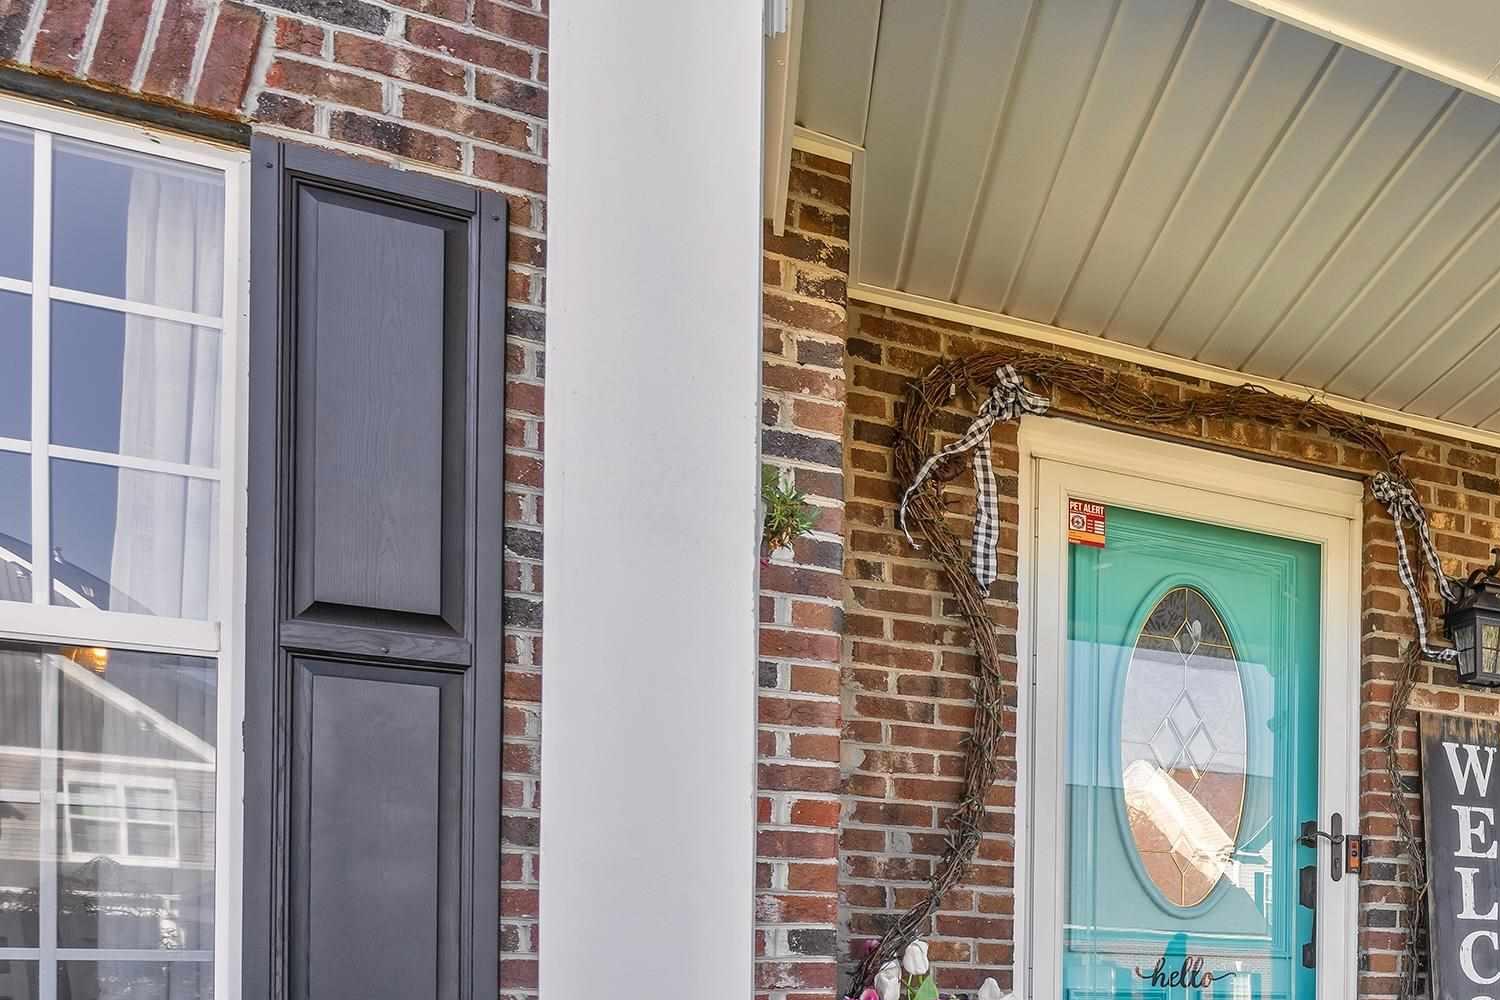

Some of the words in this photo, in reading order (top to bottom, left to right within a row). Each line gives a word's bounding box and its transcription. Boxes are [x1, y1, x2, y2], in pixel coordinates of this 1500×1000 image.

[1070, 502, 1082, 511] PET
[1084, 504, 1105, 516] ALERT
[1136, 957, 1236, 988] hello
